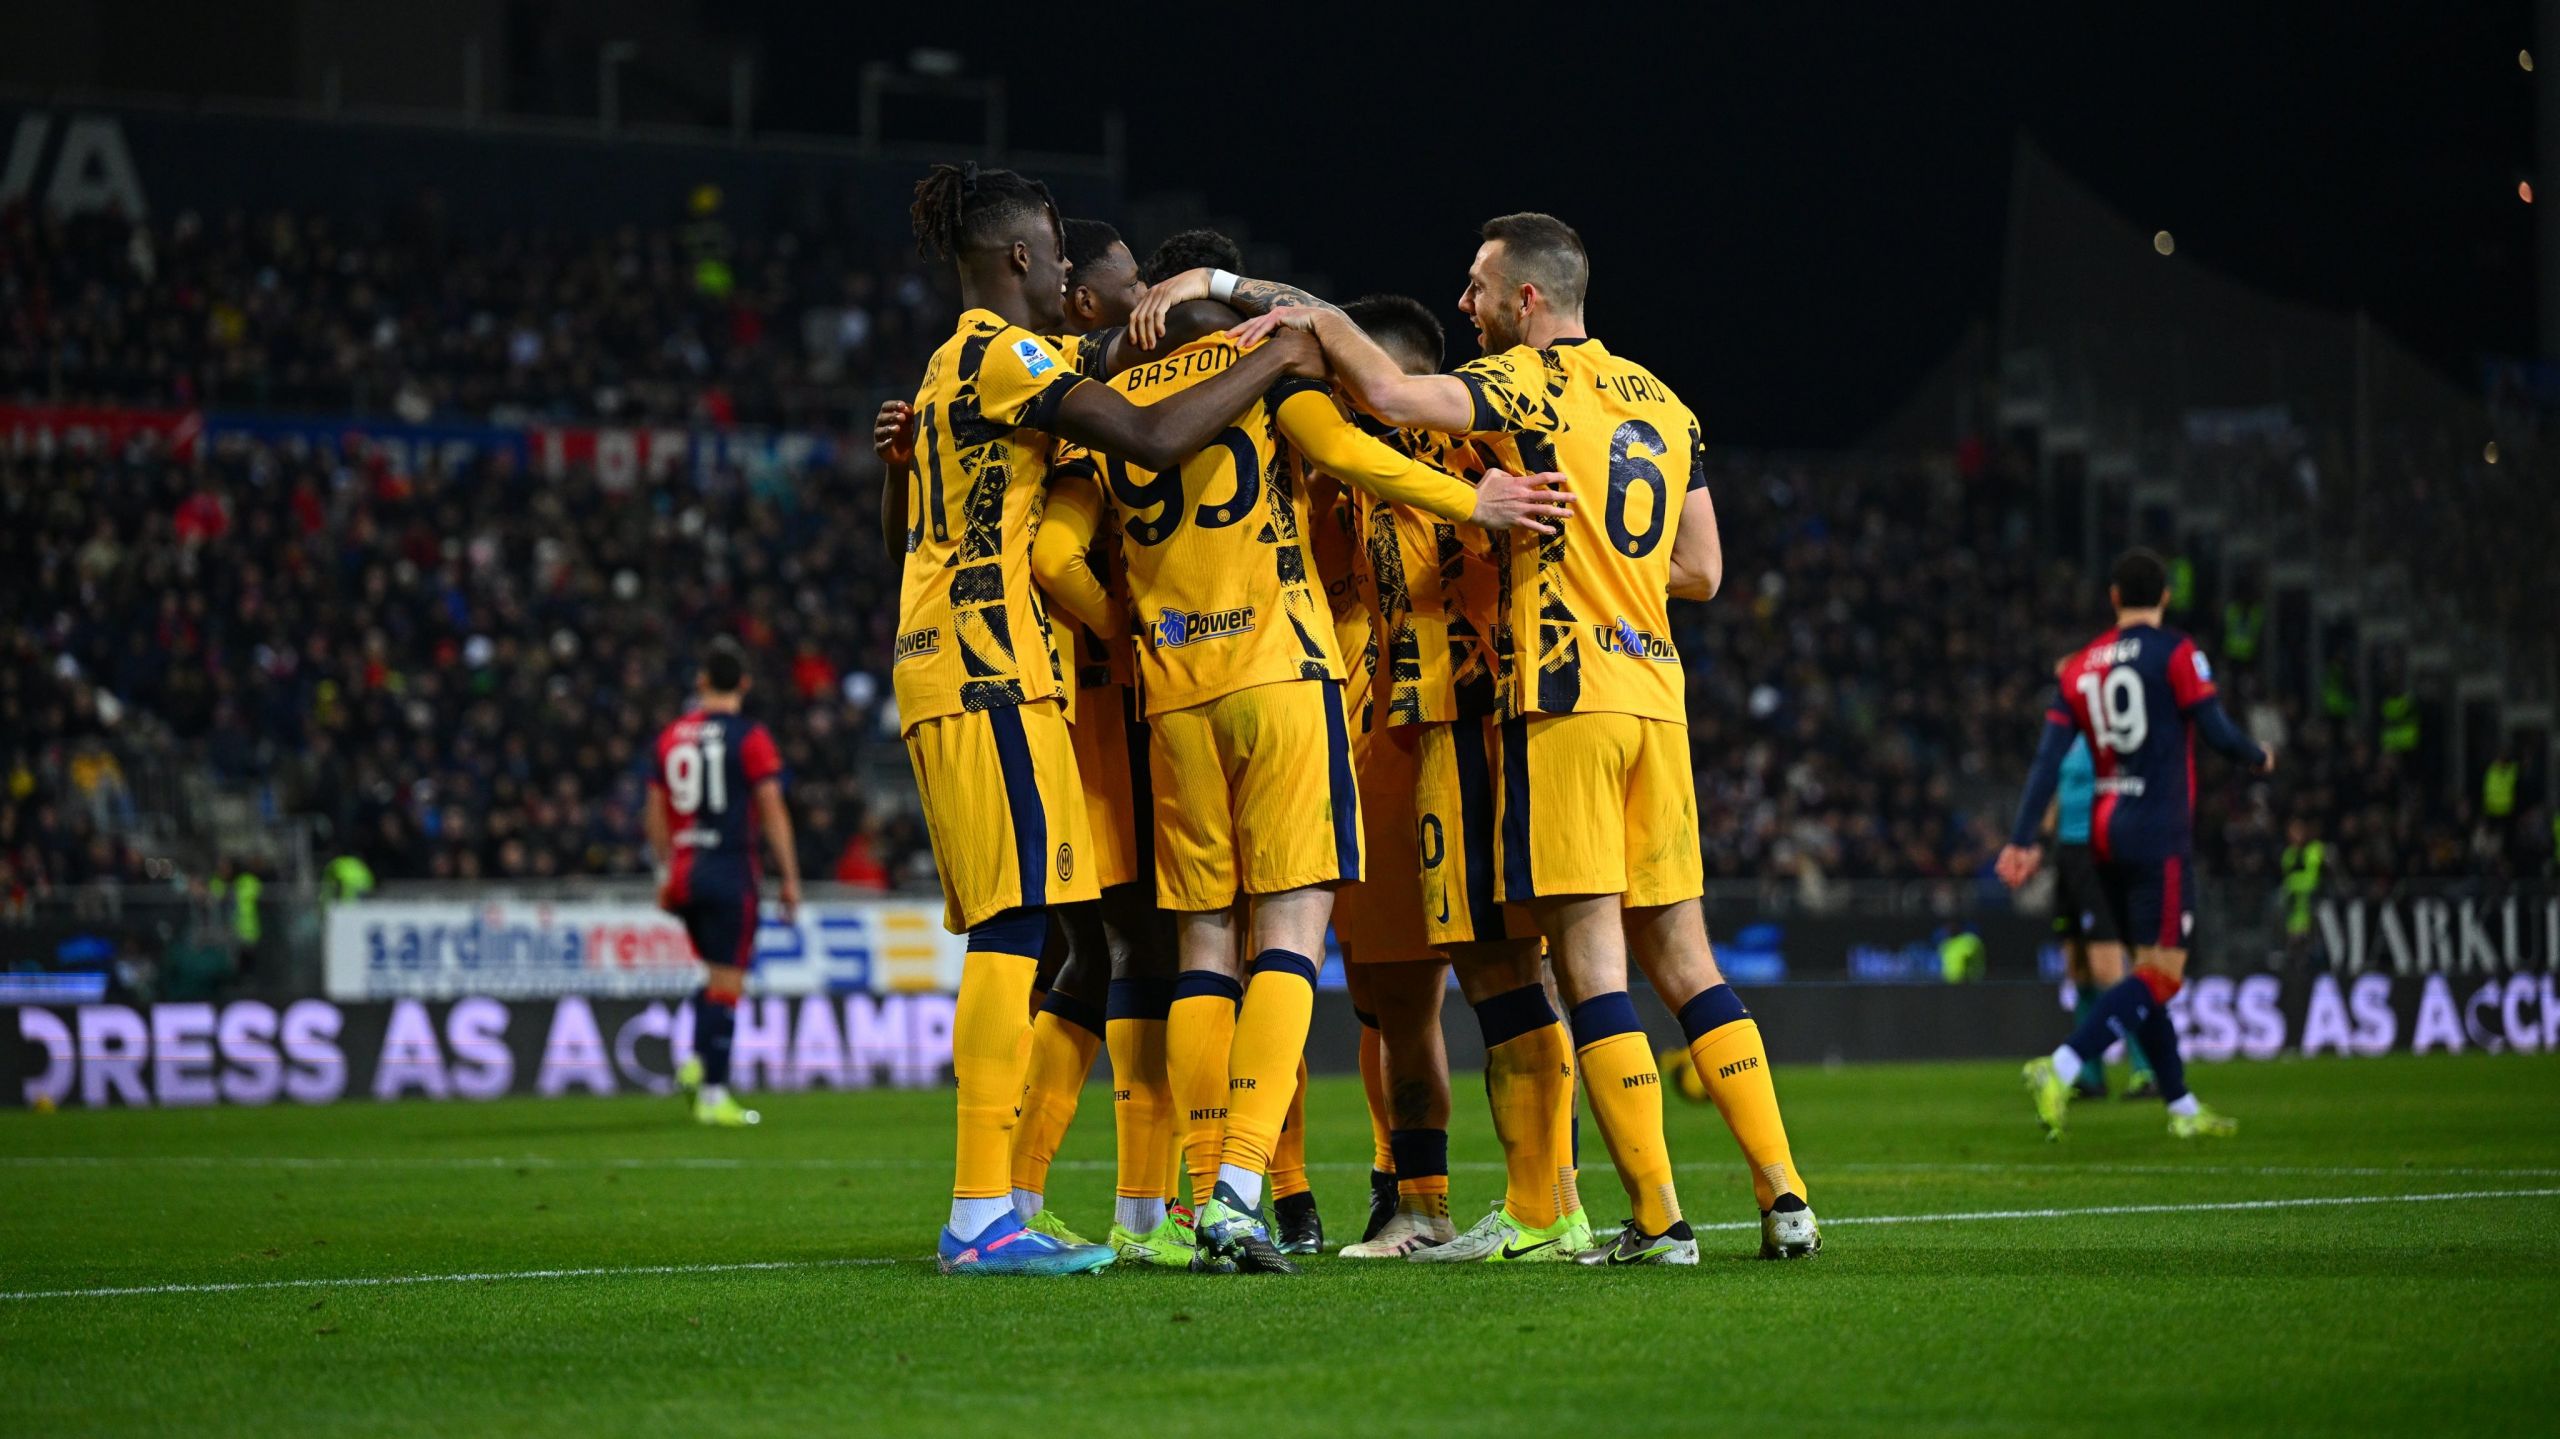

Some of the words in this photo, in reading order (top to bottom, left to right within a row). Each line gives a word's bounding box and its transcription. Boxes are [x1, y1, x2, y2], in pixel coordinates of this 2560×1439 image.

[1604, 419, 1668, 559] 6
[896, 629, 938, 658] ower
[2076, 665, 2148, 756] 19
[664, 740, 728, 817] 91
[370, 995, 516, 1098] AS
[535, 995, 619, 1097] A
[2300, 971, 2398, 1060] AS
[2411, 971, 2467, 1056] A
[1622, 1073, 1659, 1089] INTER
[1719, 1057, 1758, 1079] INTER
[1190, 1108, 1228, 1120] INTER
